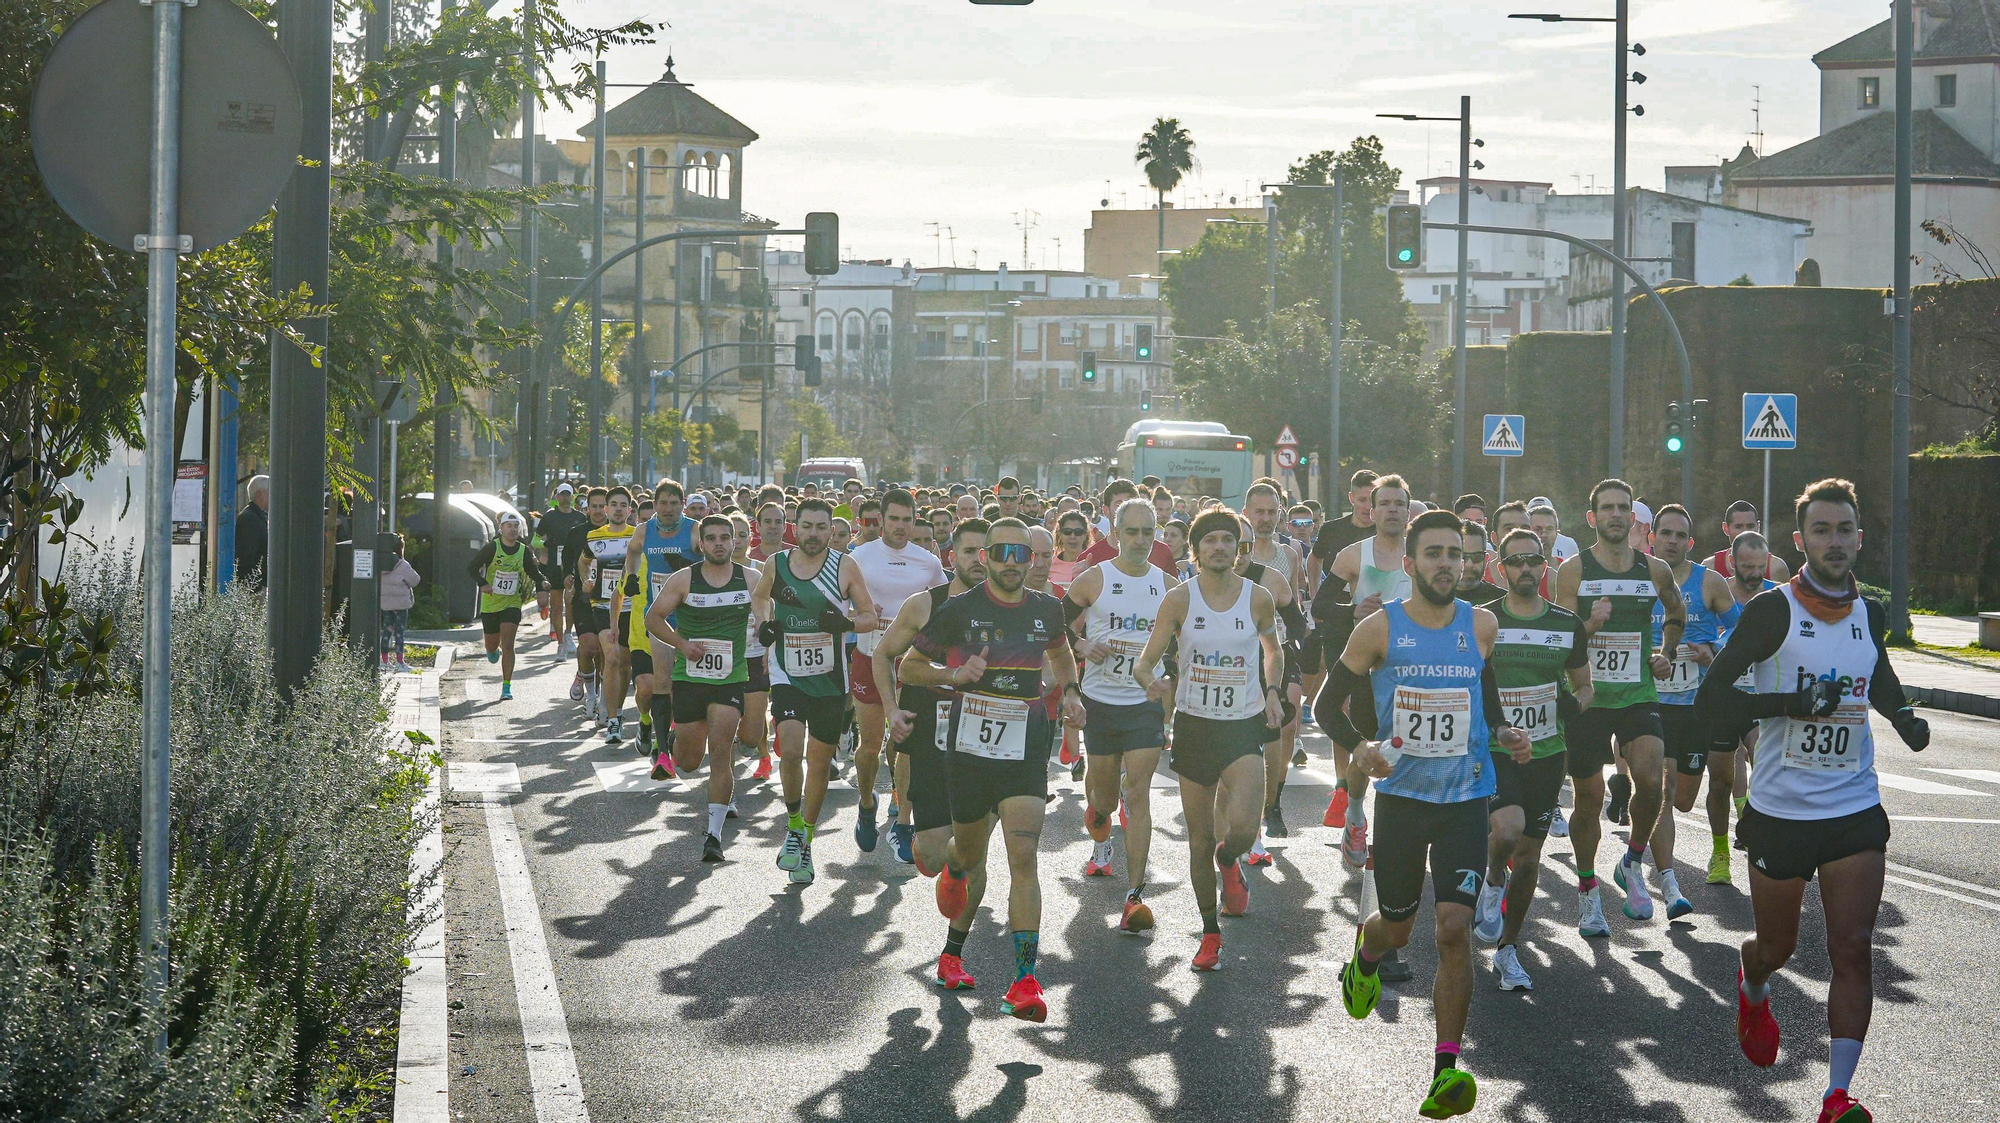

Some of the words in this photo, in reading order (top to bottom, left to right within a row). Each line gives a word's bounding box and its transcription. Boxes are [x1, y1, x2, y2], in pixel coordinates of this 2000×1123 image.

[497, 580, 513, 590] 437
[786, 636, 801, 648] XLII
[696, 654, 722, 670] 290
[795, 648, 823, 666] 135
[1193, 649, 1245, 667] indea
[1494, 650, 1524, 658] LETISMO
[1597, 650, 1630, 671] 287
[1113, 655, 1135, 675] 21
[1394, 664, 1477, 678] TROTASIERRA
[1670, 662, 1687, 681] 71
[1190, 667, 1209, 683] XLII
[1200, 685, 1234, 708] 113
[1396, 690, 1422, 712] XLII
[1500, 692, 1521, 706] XLII
[965, 697, 988, 717] XLII
[1512, 705, 1547, 729] 204
[980, 719, 1007, 745] 57
[1408, 713, 1454, 741] 213
[1801, 724, 1849, 755] 330
